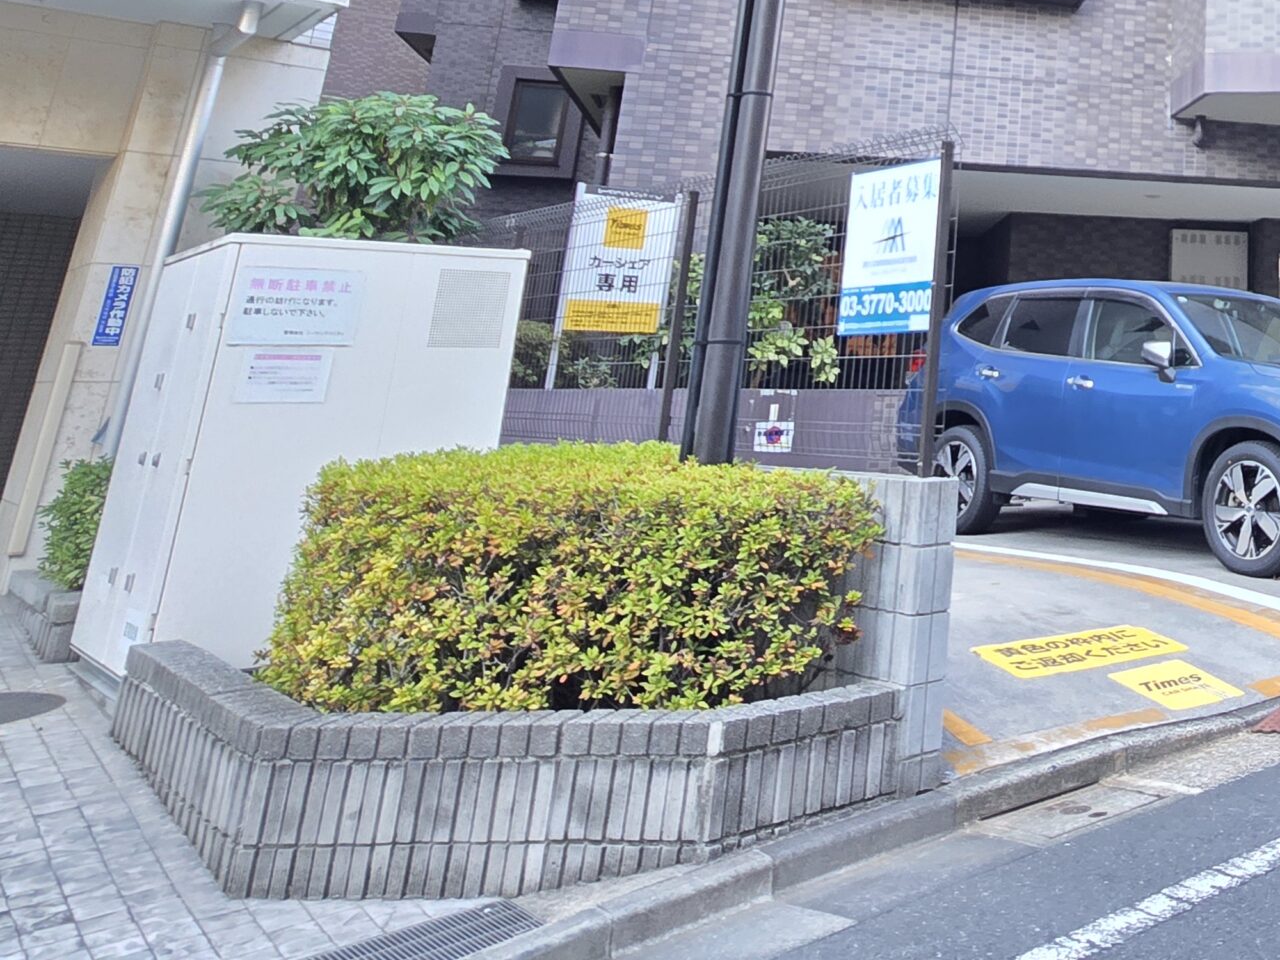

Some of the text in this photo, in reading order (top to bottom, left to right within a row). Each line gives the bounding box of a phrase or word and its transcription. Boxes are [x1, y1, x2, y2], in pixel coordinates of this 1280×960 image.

[588, 255, 650, 271] カーシェア
[249, 278, 353, 294] 無断駐車禁止
[595, 273, 639, 294] 専用
[841, 289, 932, 318] 03-3770-3000
[993, 630, 1137, 658] 黄色の枠内に
[1010, 639, 1169, 671] ご返却ください
[1138, 672, 1203, 692] Times
